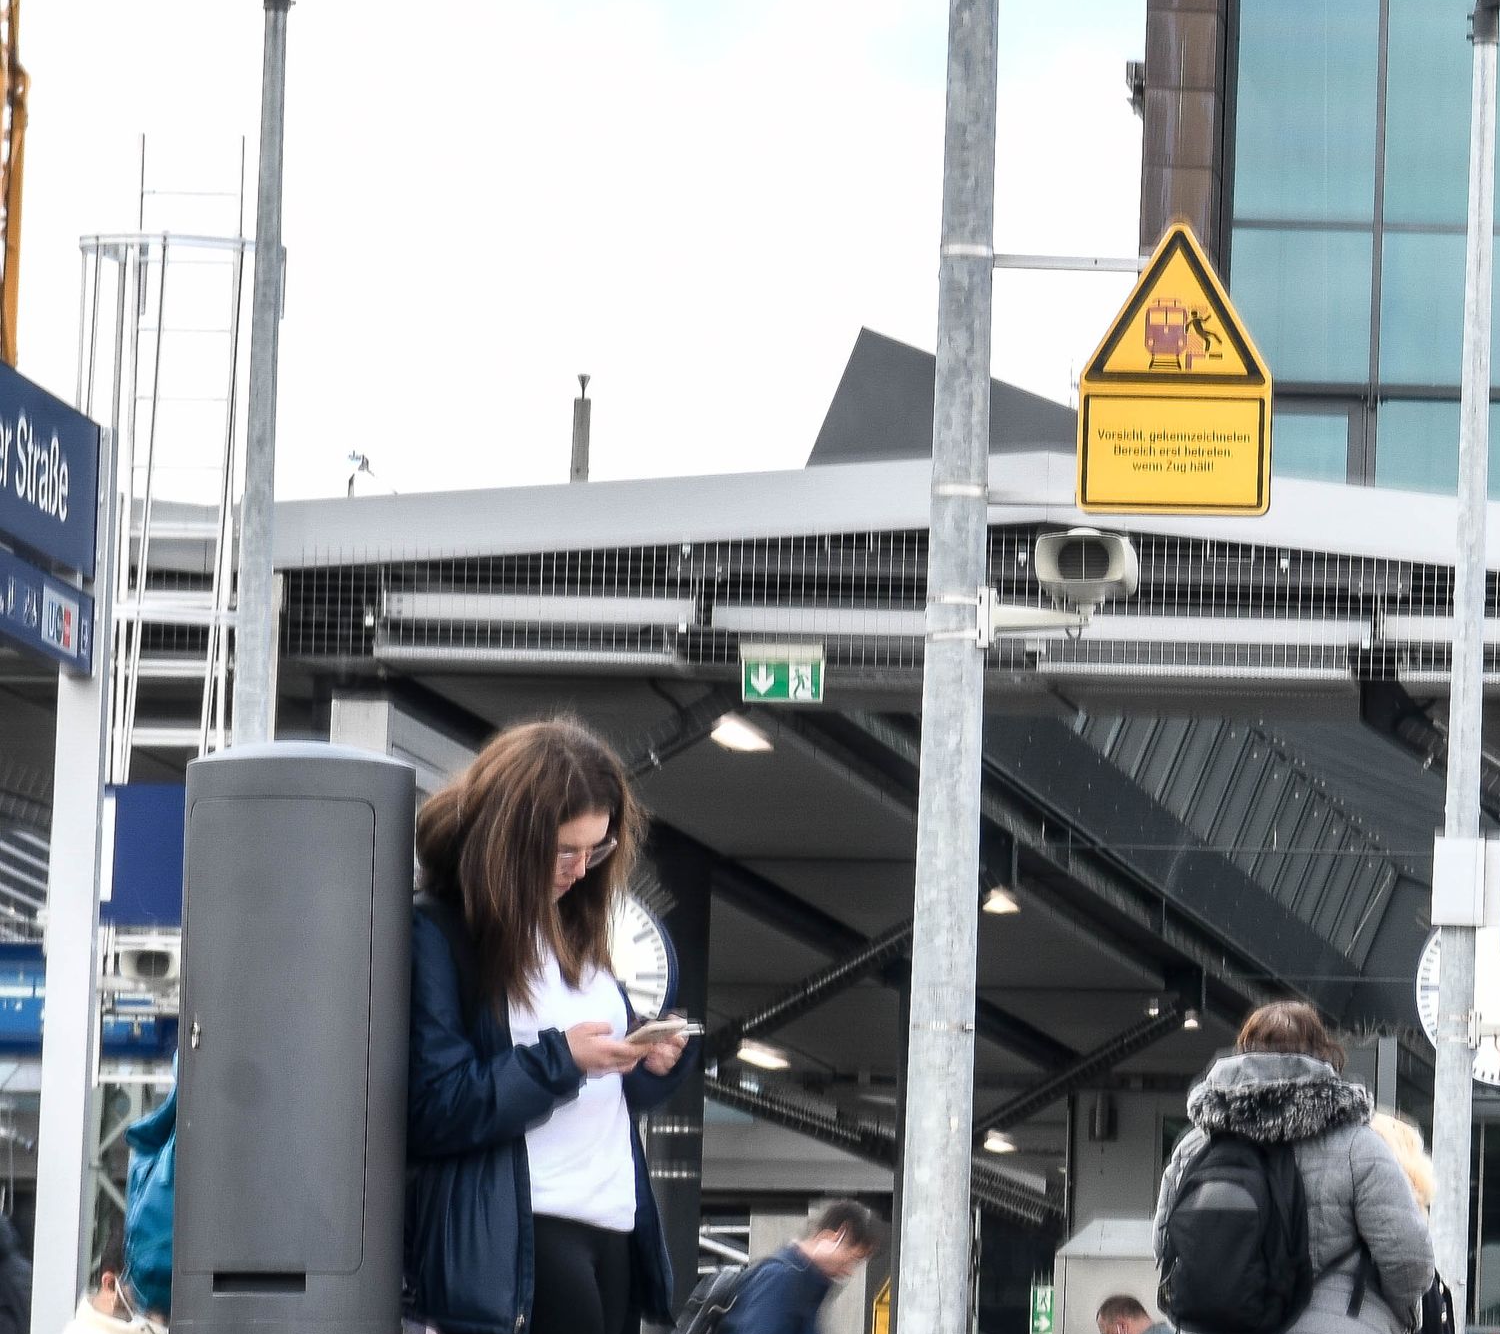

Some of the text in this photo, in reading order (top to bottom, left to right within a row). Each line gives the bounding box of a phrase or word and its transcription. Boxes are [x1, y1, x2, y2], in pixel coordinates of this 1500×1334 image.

[1098, 428, 1249, 444] Vorsicht, gekennzeichneten
[1114, 444, 1156, 457] Bereich
[1159, 445, 1180, 457] erst
[15, 415, 68, 522] Straße
[1132, 459, 1214, 473] wenn Zug hält!
